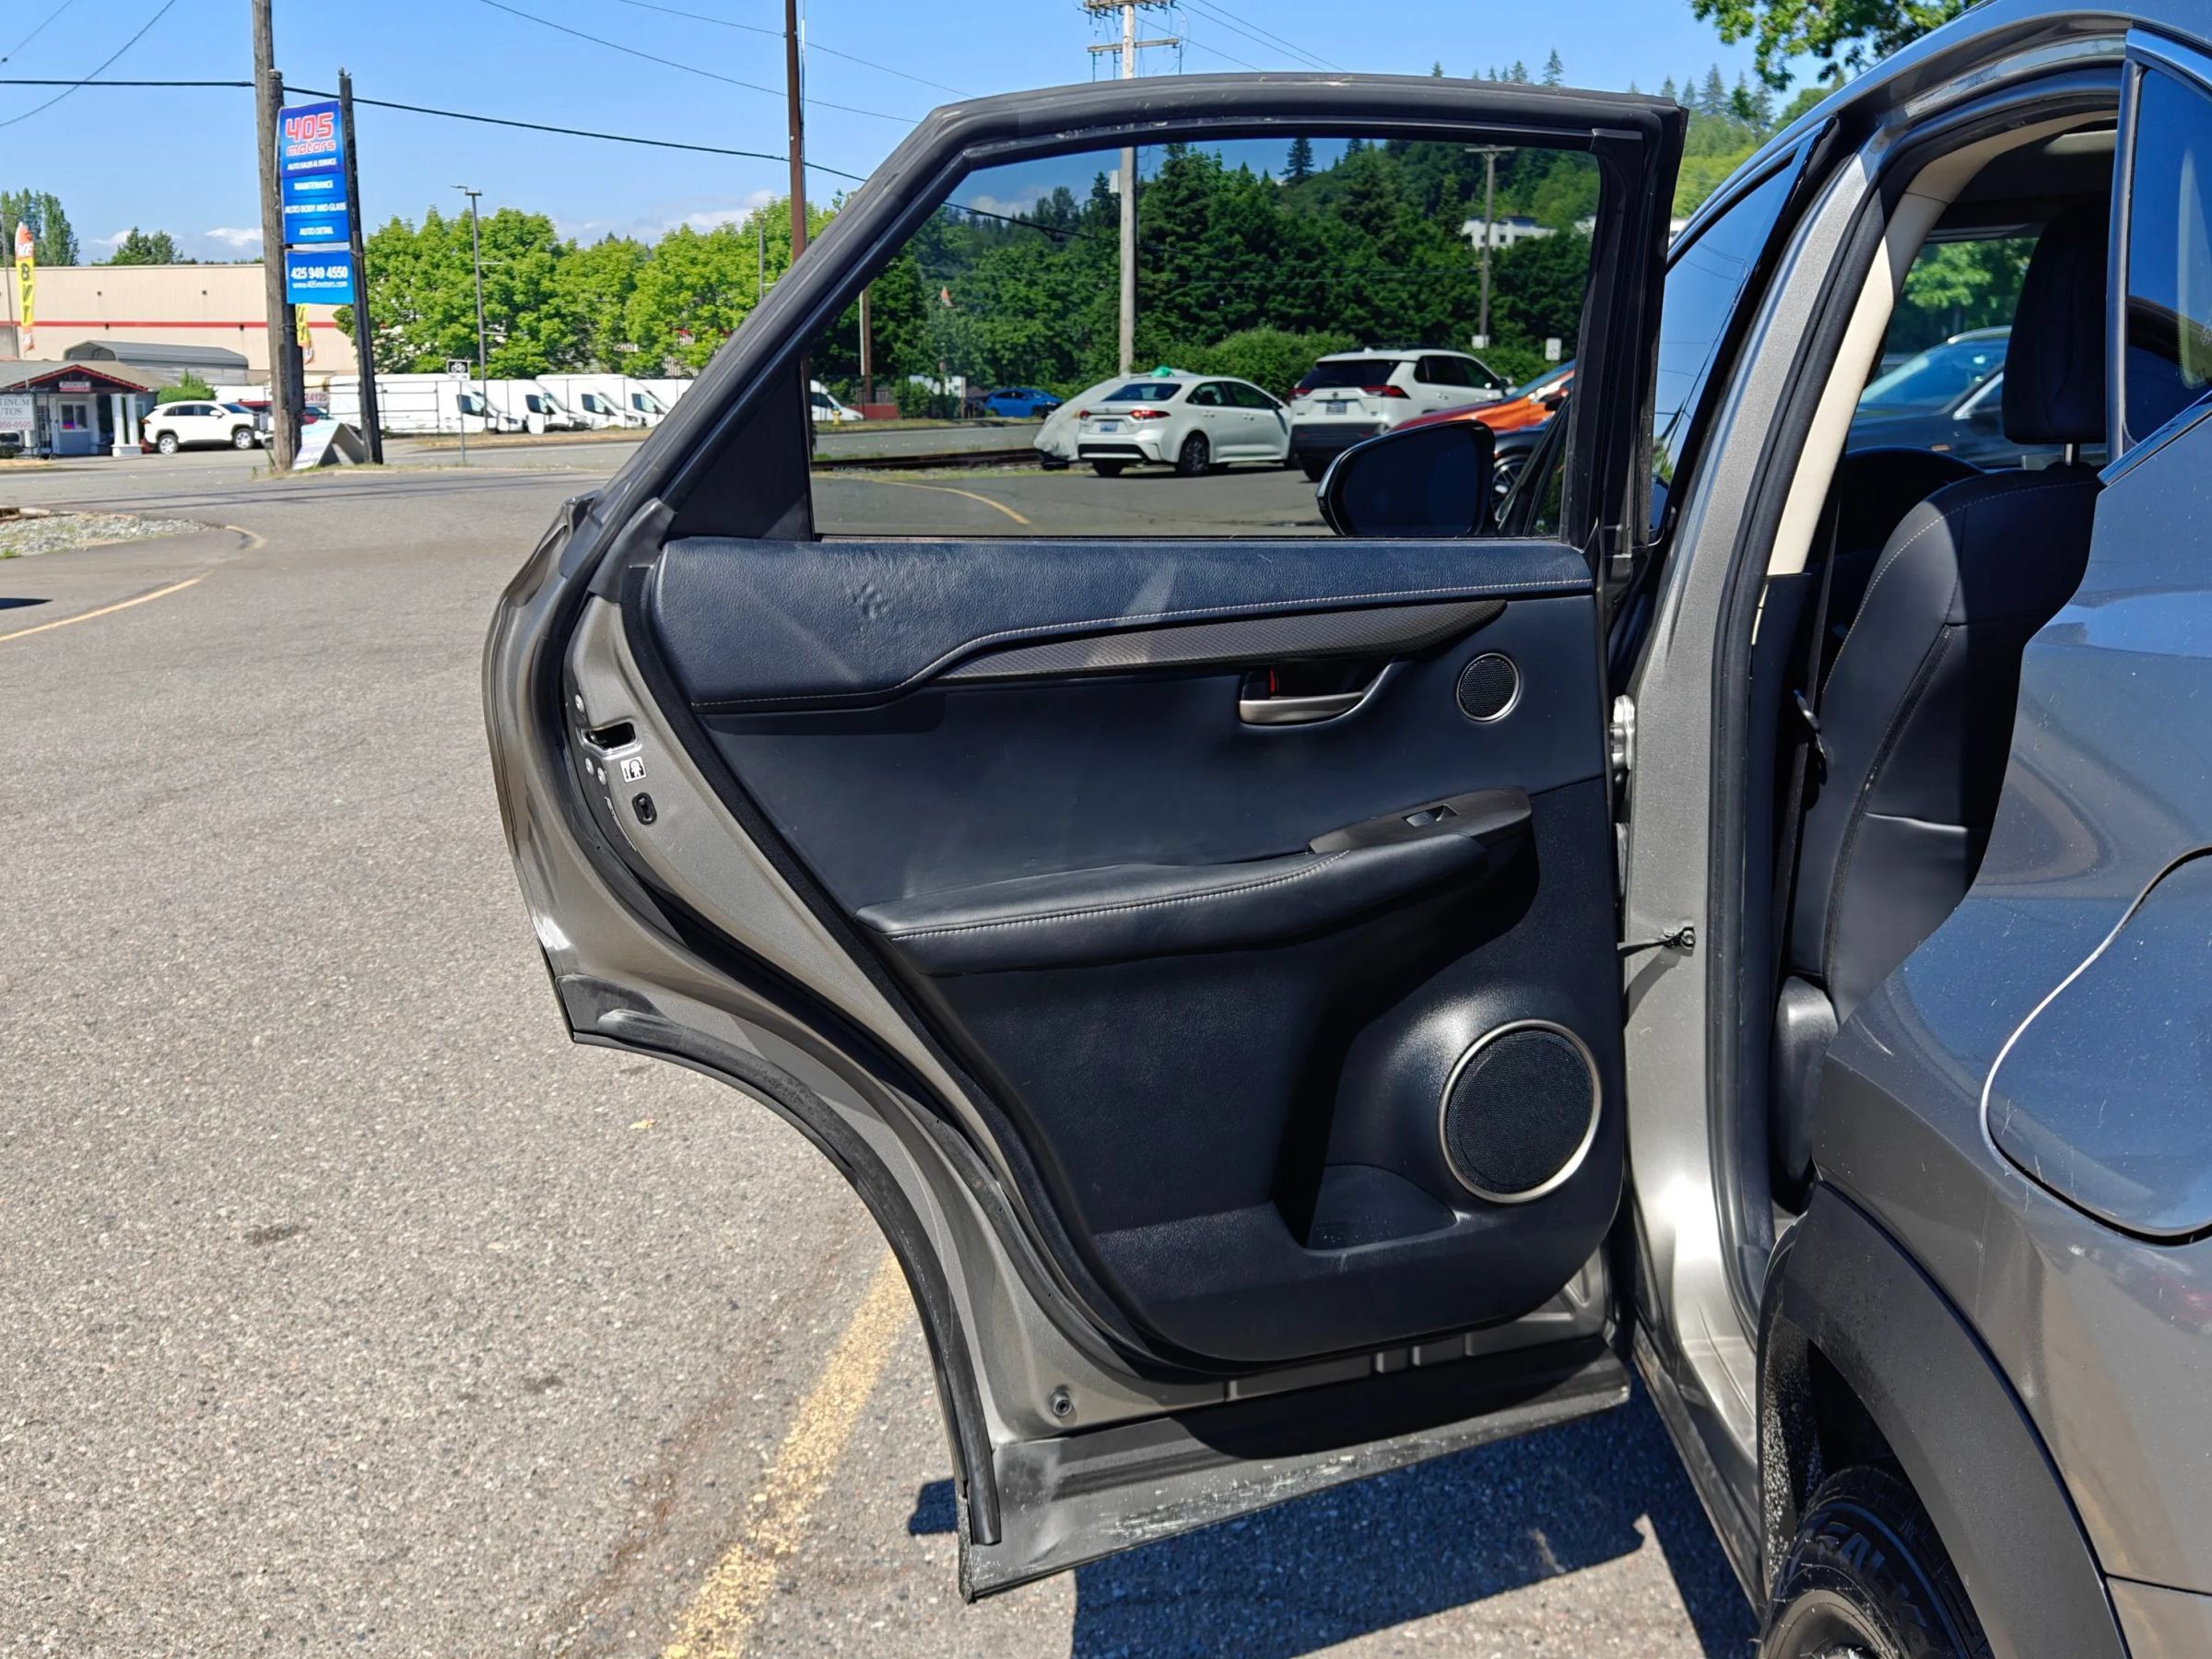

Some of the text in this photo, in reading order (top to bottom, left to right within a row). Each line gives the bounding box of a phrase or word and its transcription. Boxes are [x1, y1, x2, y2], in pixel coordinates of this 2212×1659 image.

[286, 112, 334, 141] 405
[287, 140, 335, 158] motors
[291, 266, 307, 279] 425
